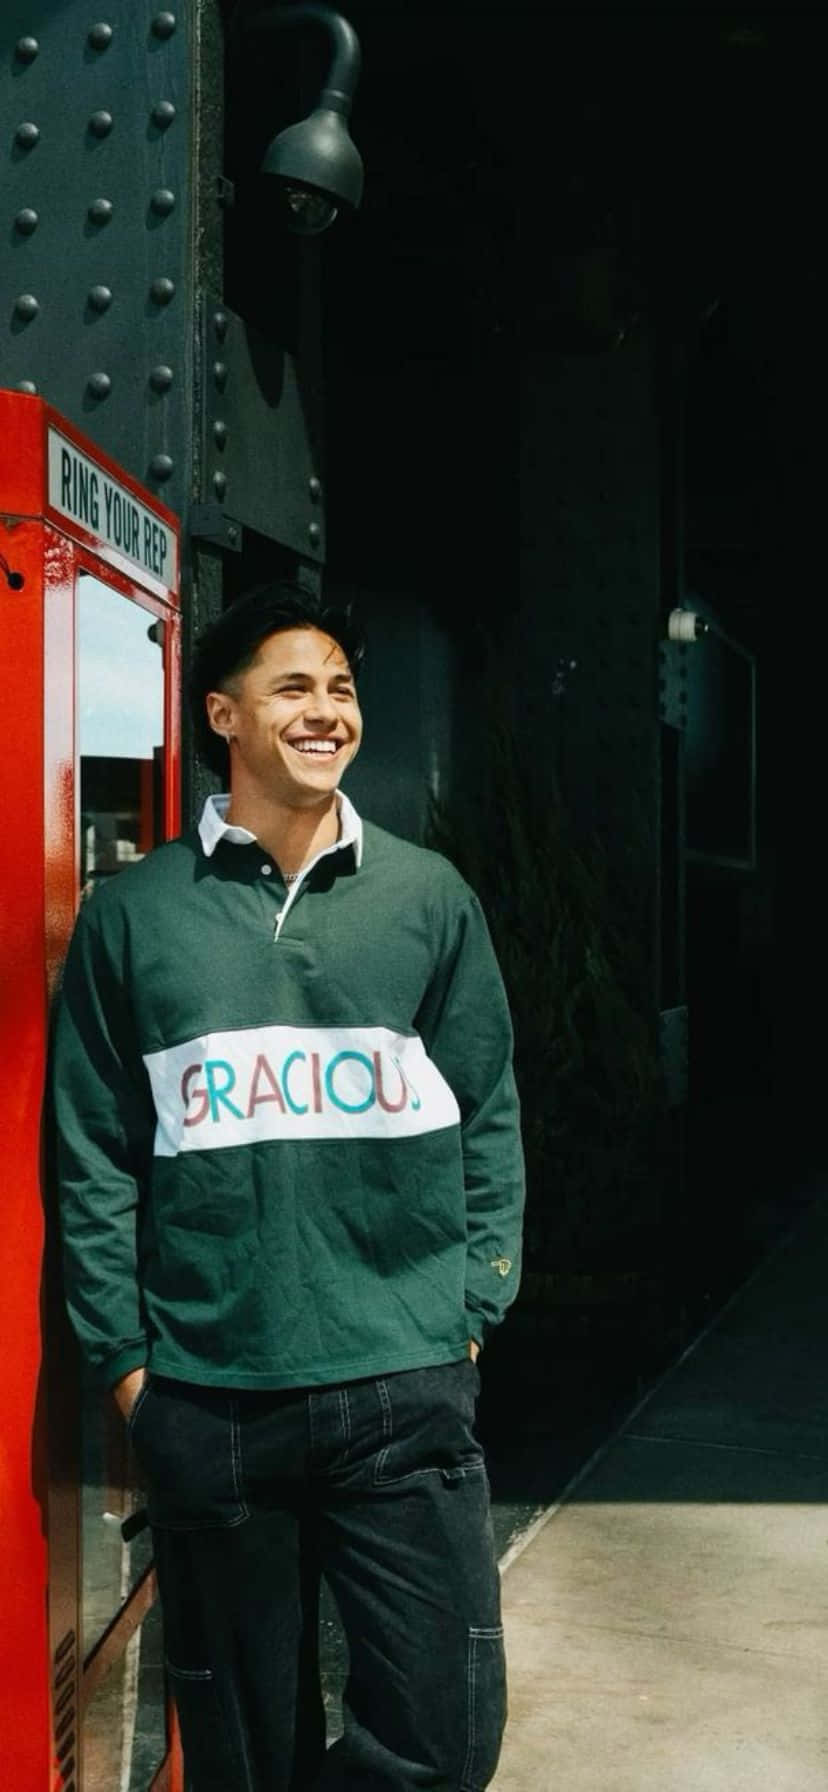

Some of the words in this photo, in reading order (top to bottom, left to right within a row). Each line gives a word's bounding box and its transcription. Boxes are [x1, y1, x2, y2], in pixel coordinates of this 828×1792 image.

[61, 448, 99, 531] RING
[104, 483, 140, 561] YOUR
[144, 516, 167, 577] REP
